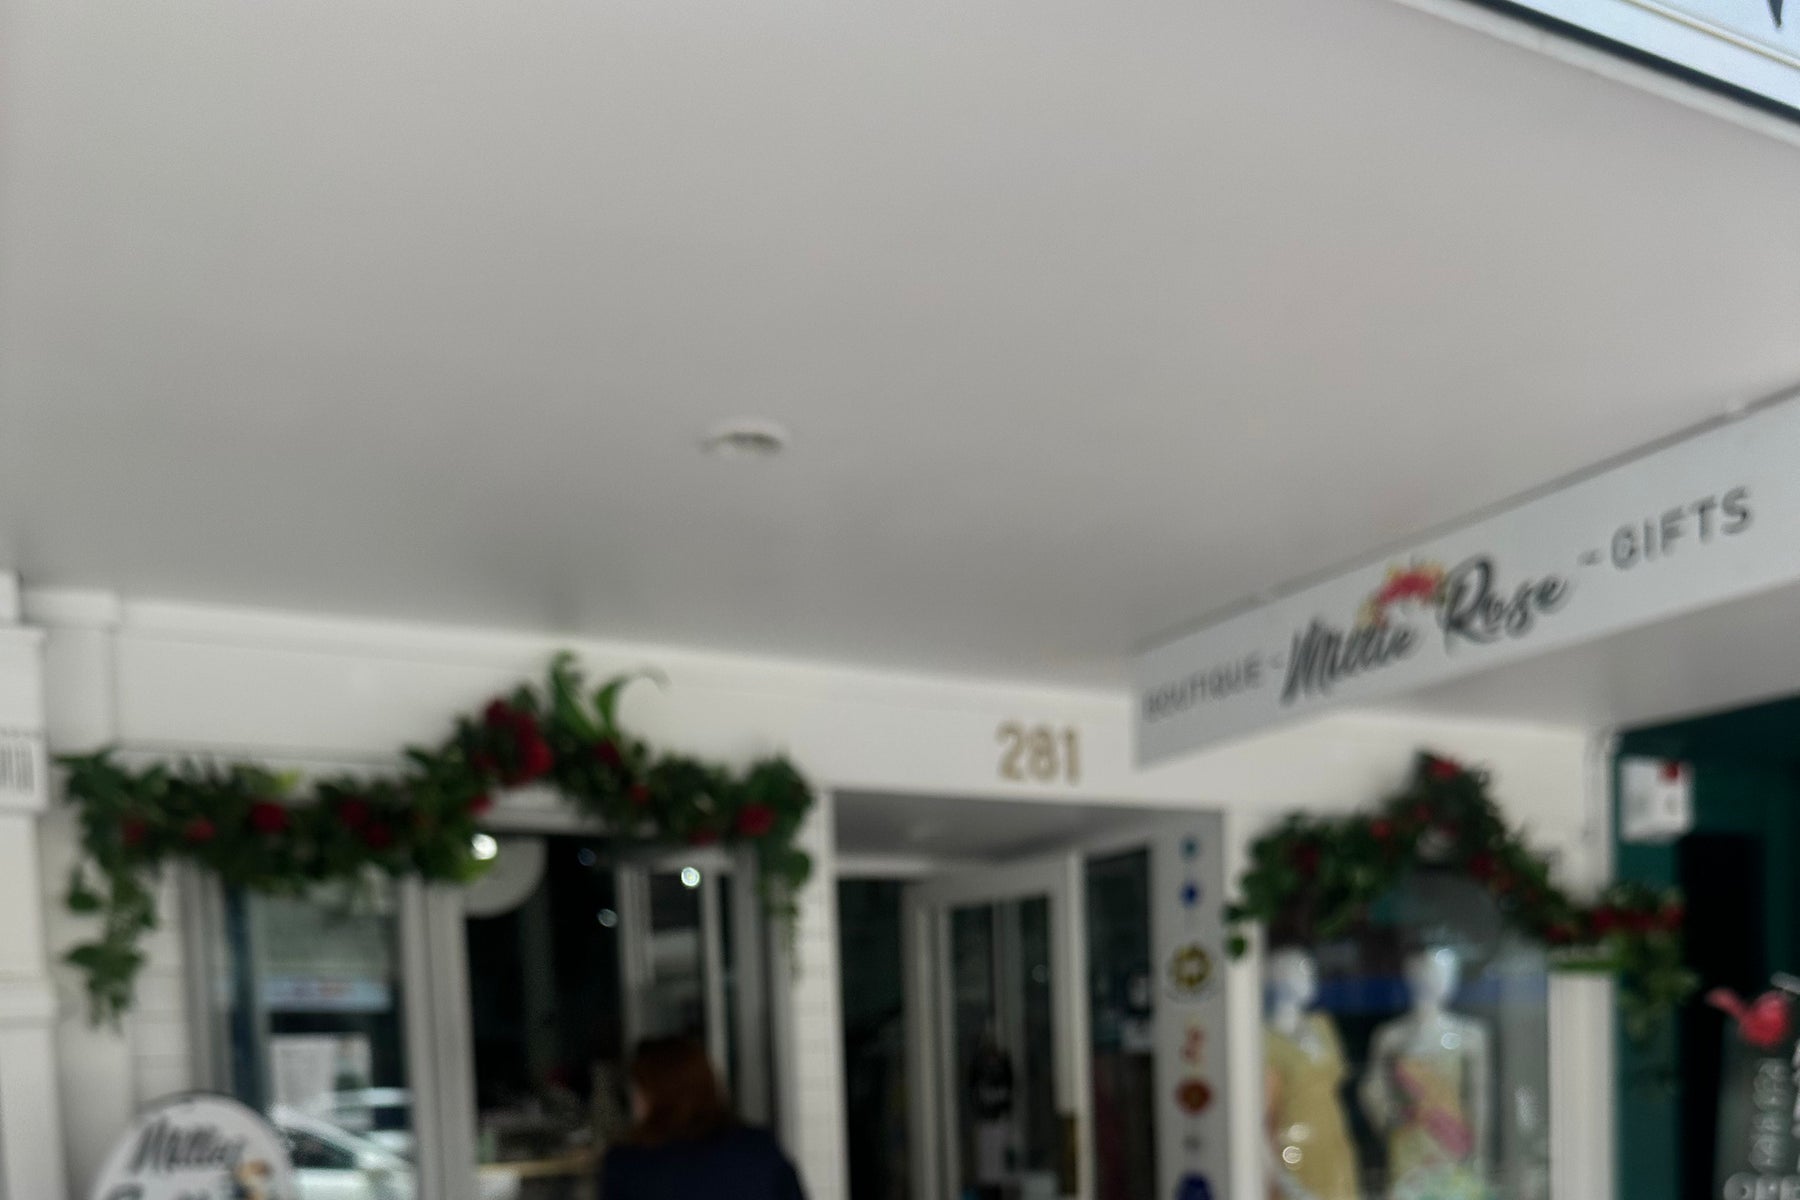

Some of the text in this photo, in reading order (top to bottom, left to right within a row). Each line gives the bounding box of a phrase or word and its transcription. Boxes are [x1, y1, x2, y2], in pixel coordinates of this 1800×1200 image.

[1145, 656, 1262, 720] BOUTIQUE
[1280, 617, 1420, 707] Millie
[1436, 553, 1568, 654] Rose
[1611, 485, 1753, 571] GIFTS
[995, 719, 1082, 786] 281
